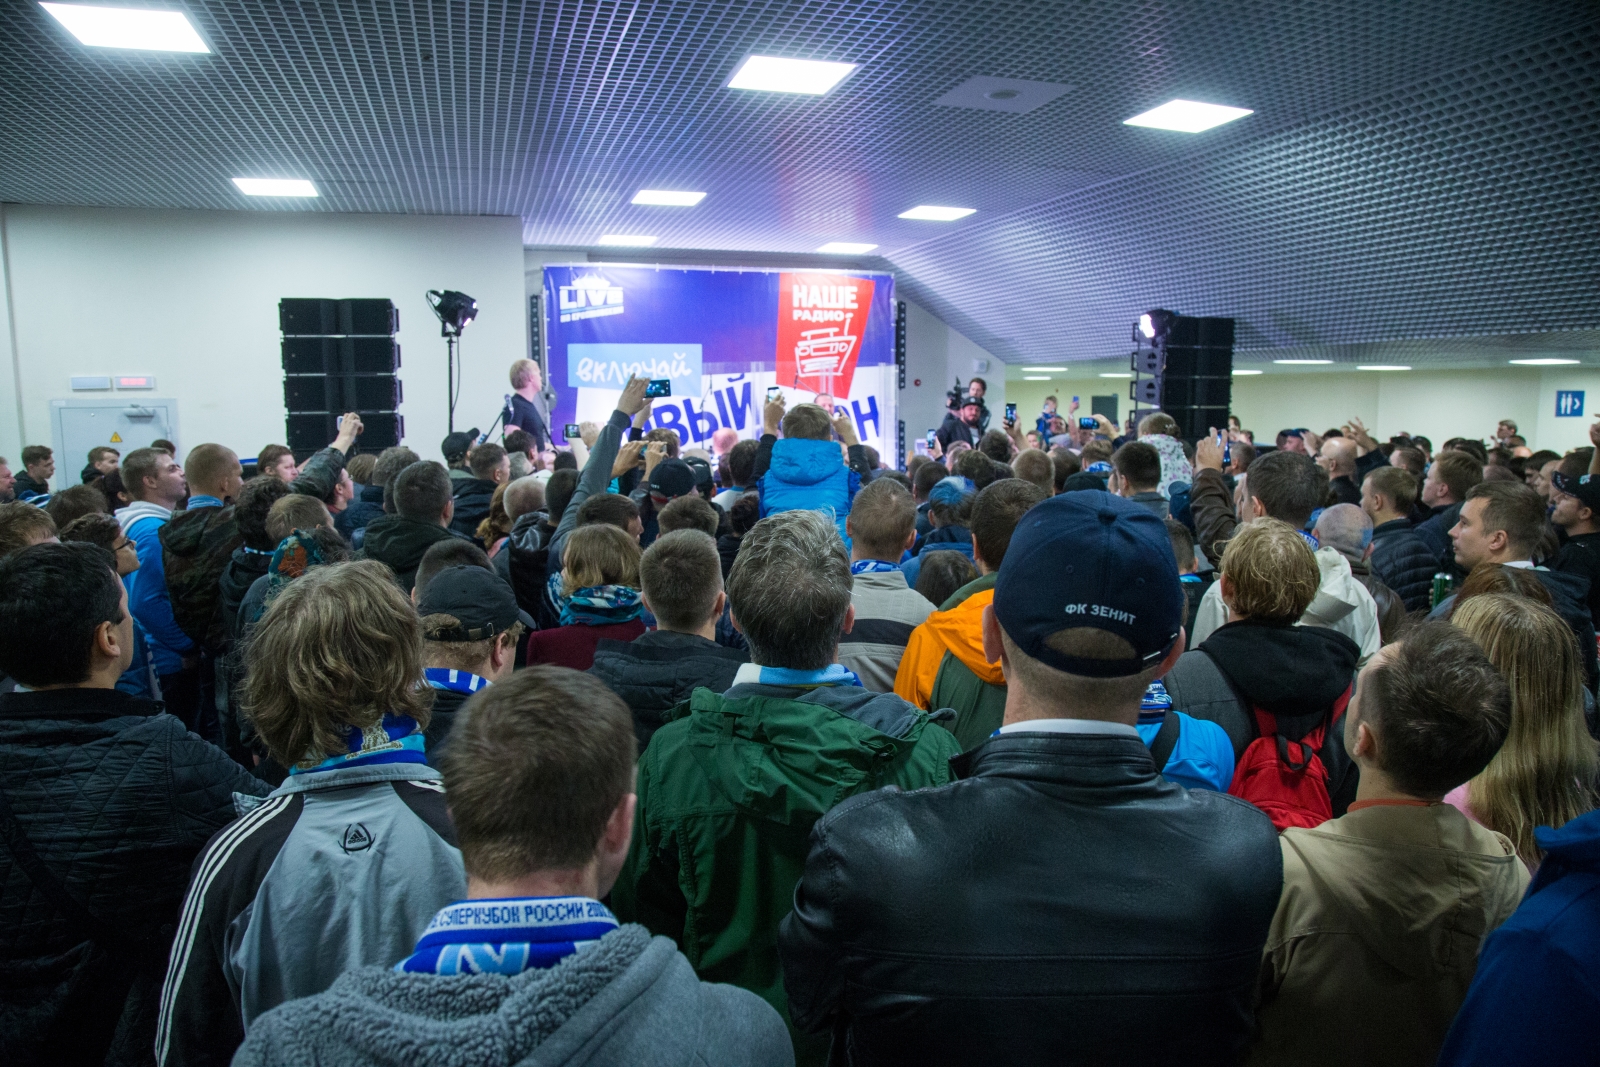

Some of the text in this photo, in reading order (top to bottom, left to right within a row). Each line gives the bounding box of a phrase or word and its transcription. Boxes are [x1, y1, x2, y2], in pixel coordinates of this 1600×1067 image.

[792, 284, 859, 310] НАШЕ
[792, 309, 845, 323] РАДИО
[620, 373, 752, 448] ВЫЙ
[1064, 603, 1136, 625] ФК ЗЕНИТ
[440, 905, 520, 928] СУПЕРКУБОК
[524, 902, 585, 923] РОССИИ
